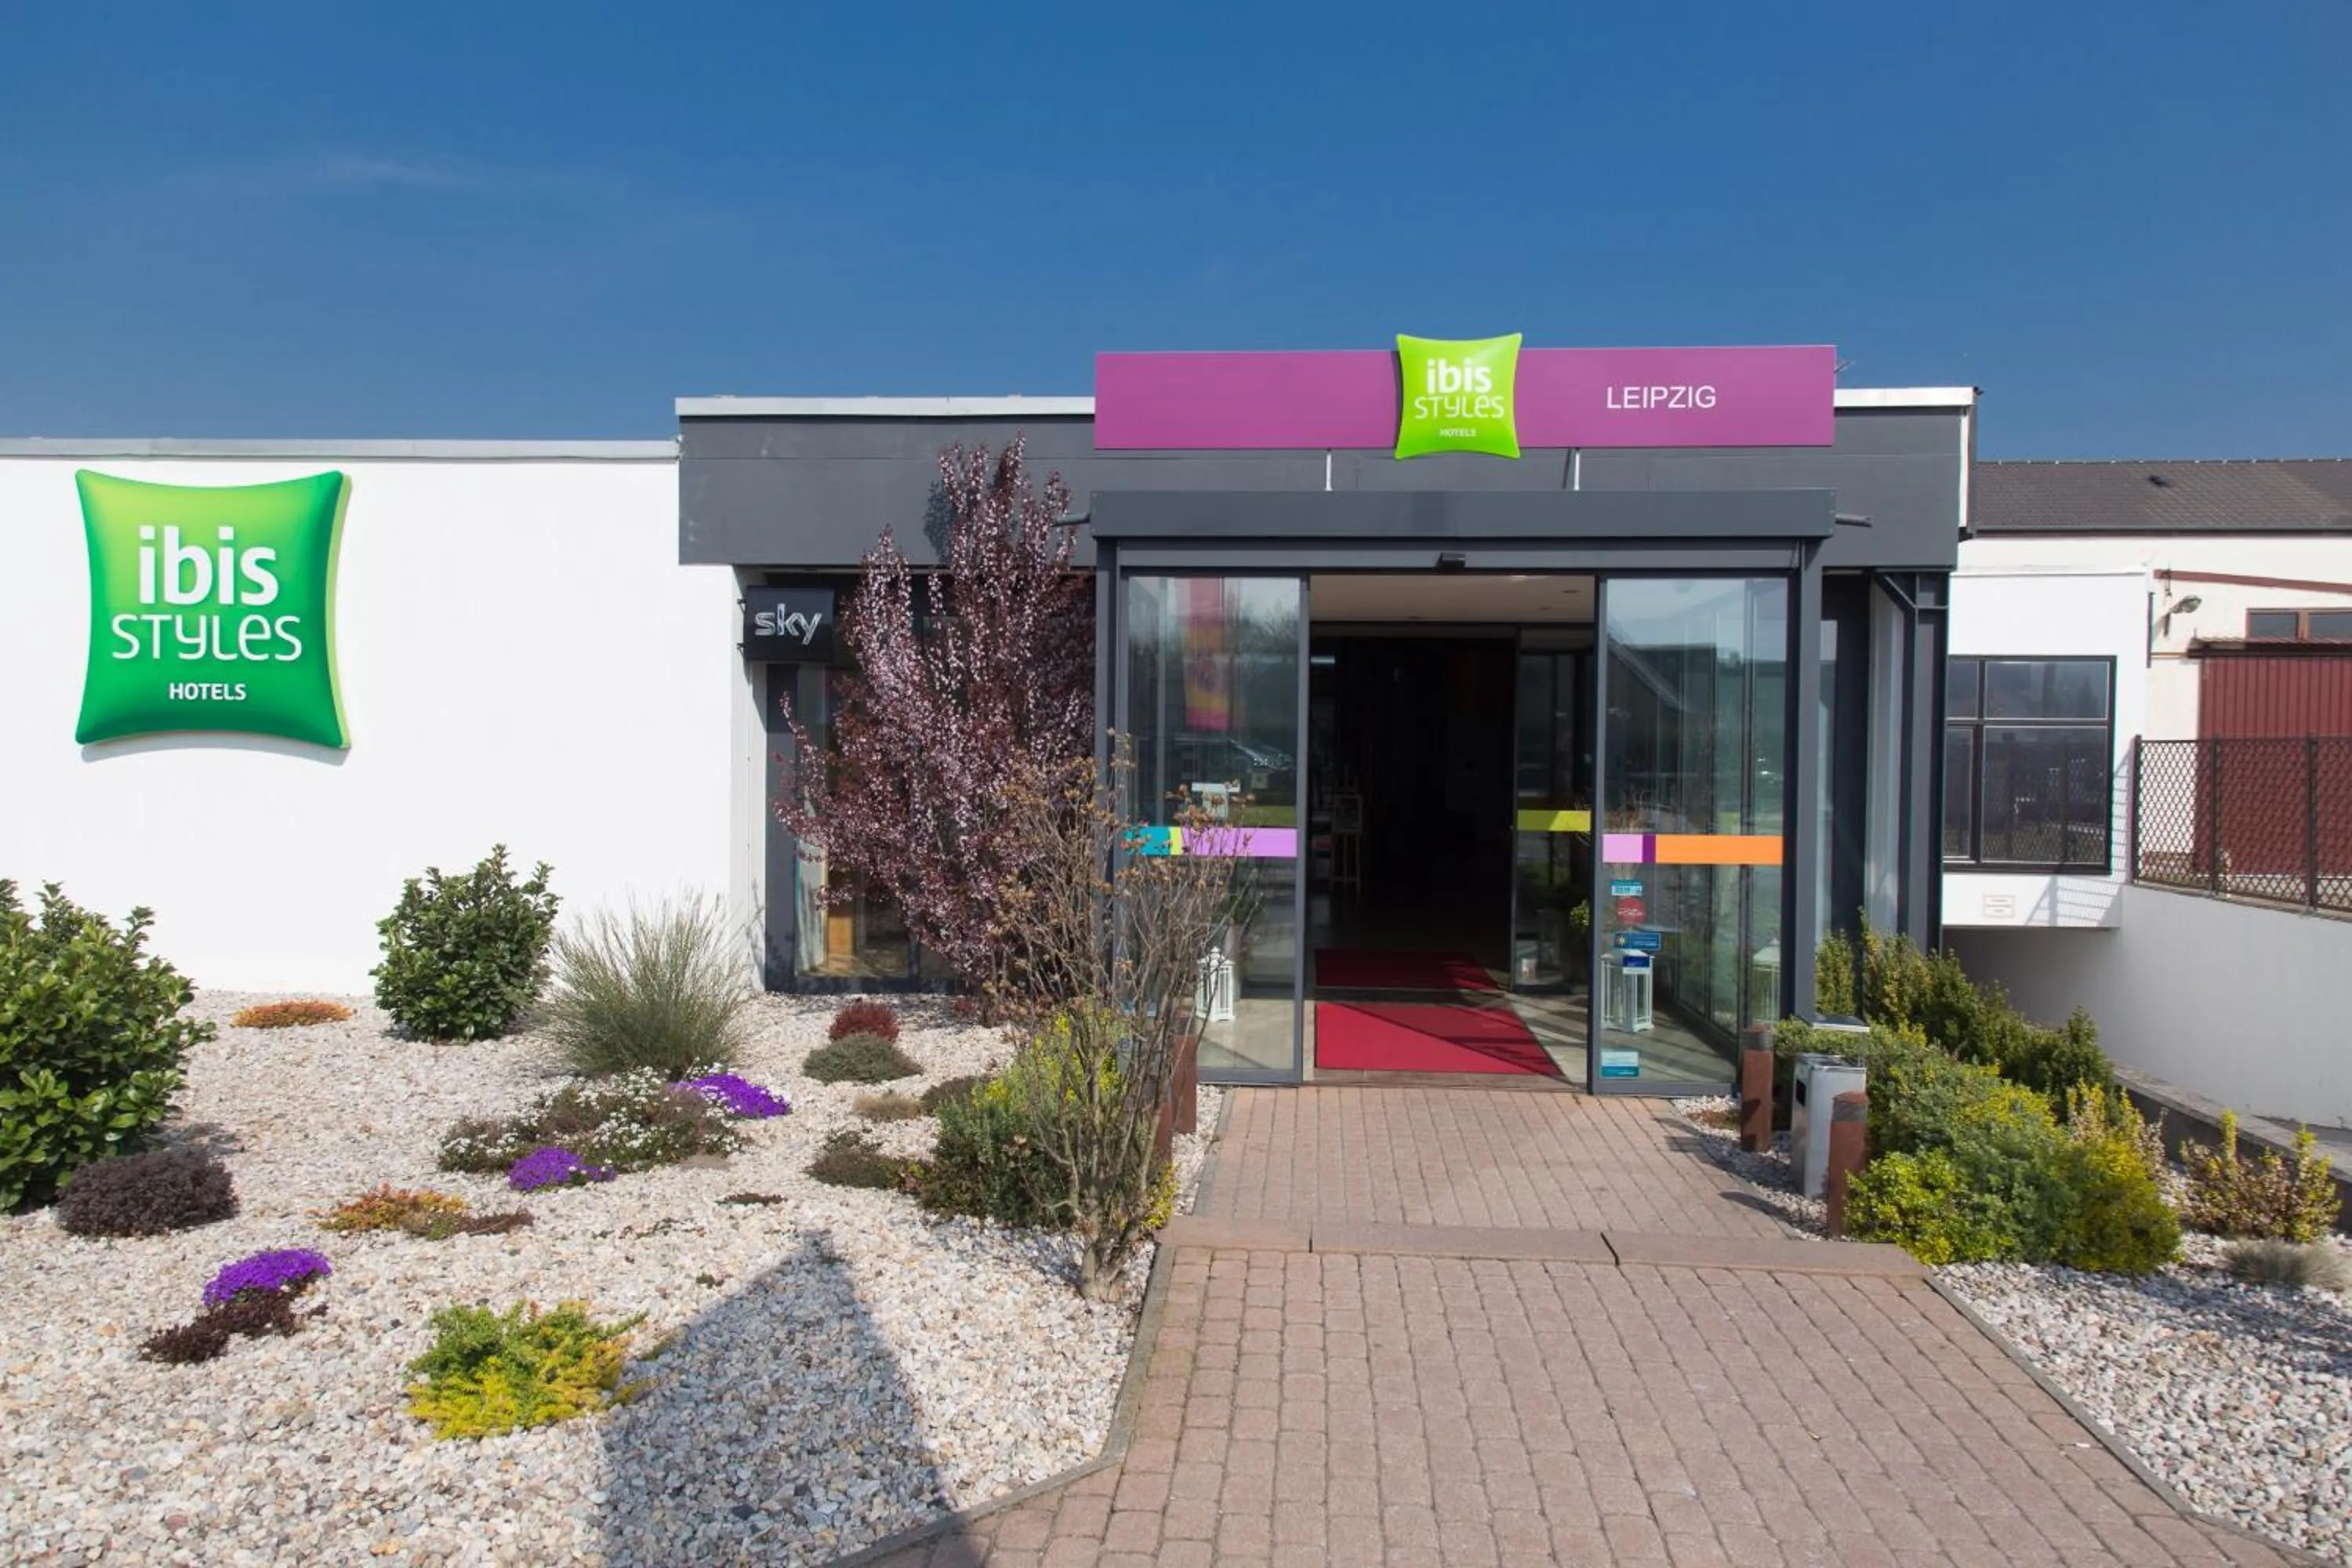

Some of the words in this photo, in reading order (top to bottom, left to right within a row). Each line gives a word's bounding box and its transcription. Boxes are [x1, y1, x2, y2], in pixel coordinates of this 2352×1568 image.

[1427, 358, 1493, 394] ibis
[1607, 386, 1716, 408] LEIPZIG
[1439, 428, 1477, 437] HOTELS
[139, 524, 279, 606] ibis
[755, 603, 822, 645] sky
[169, 683, 247, 700] HOTELS
